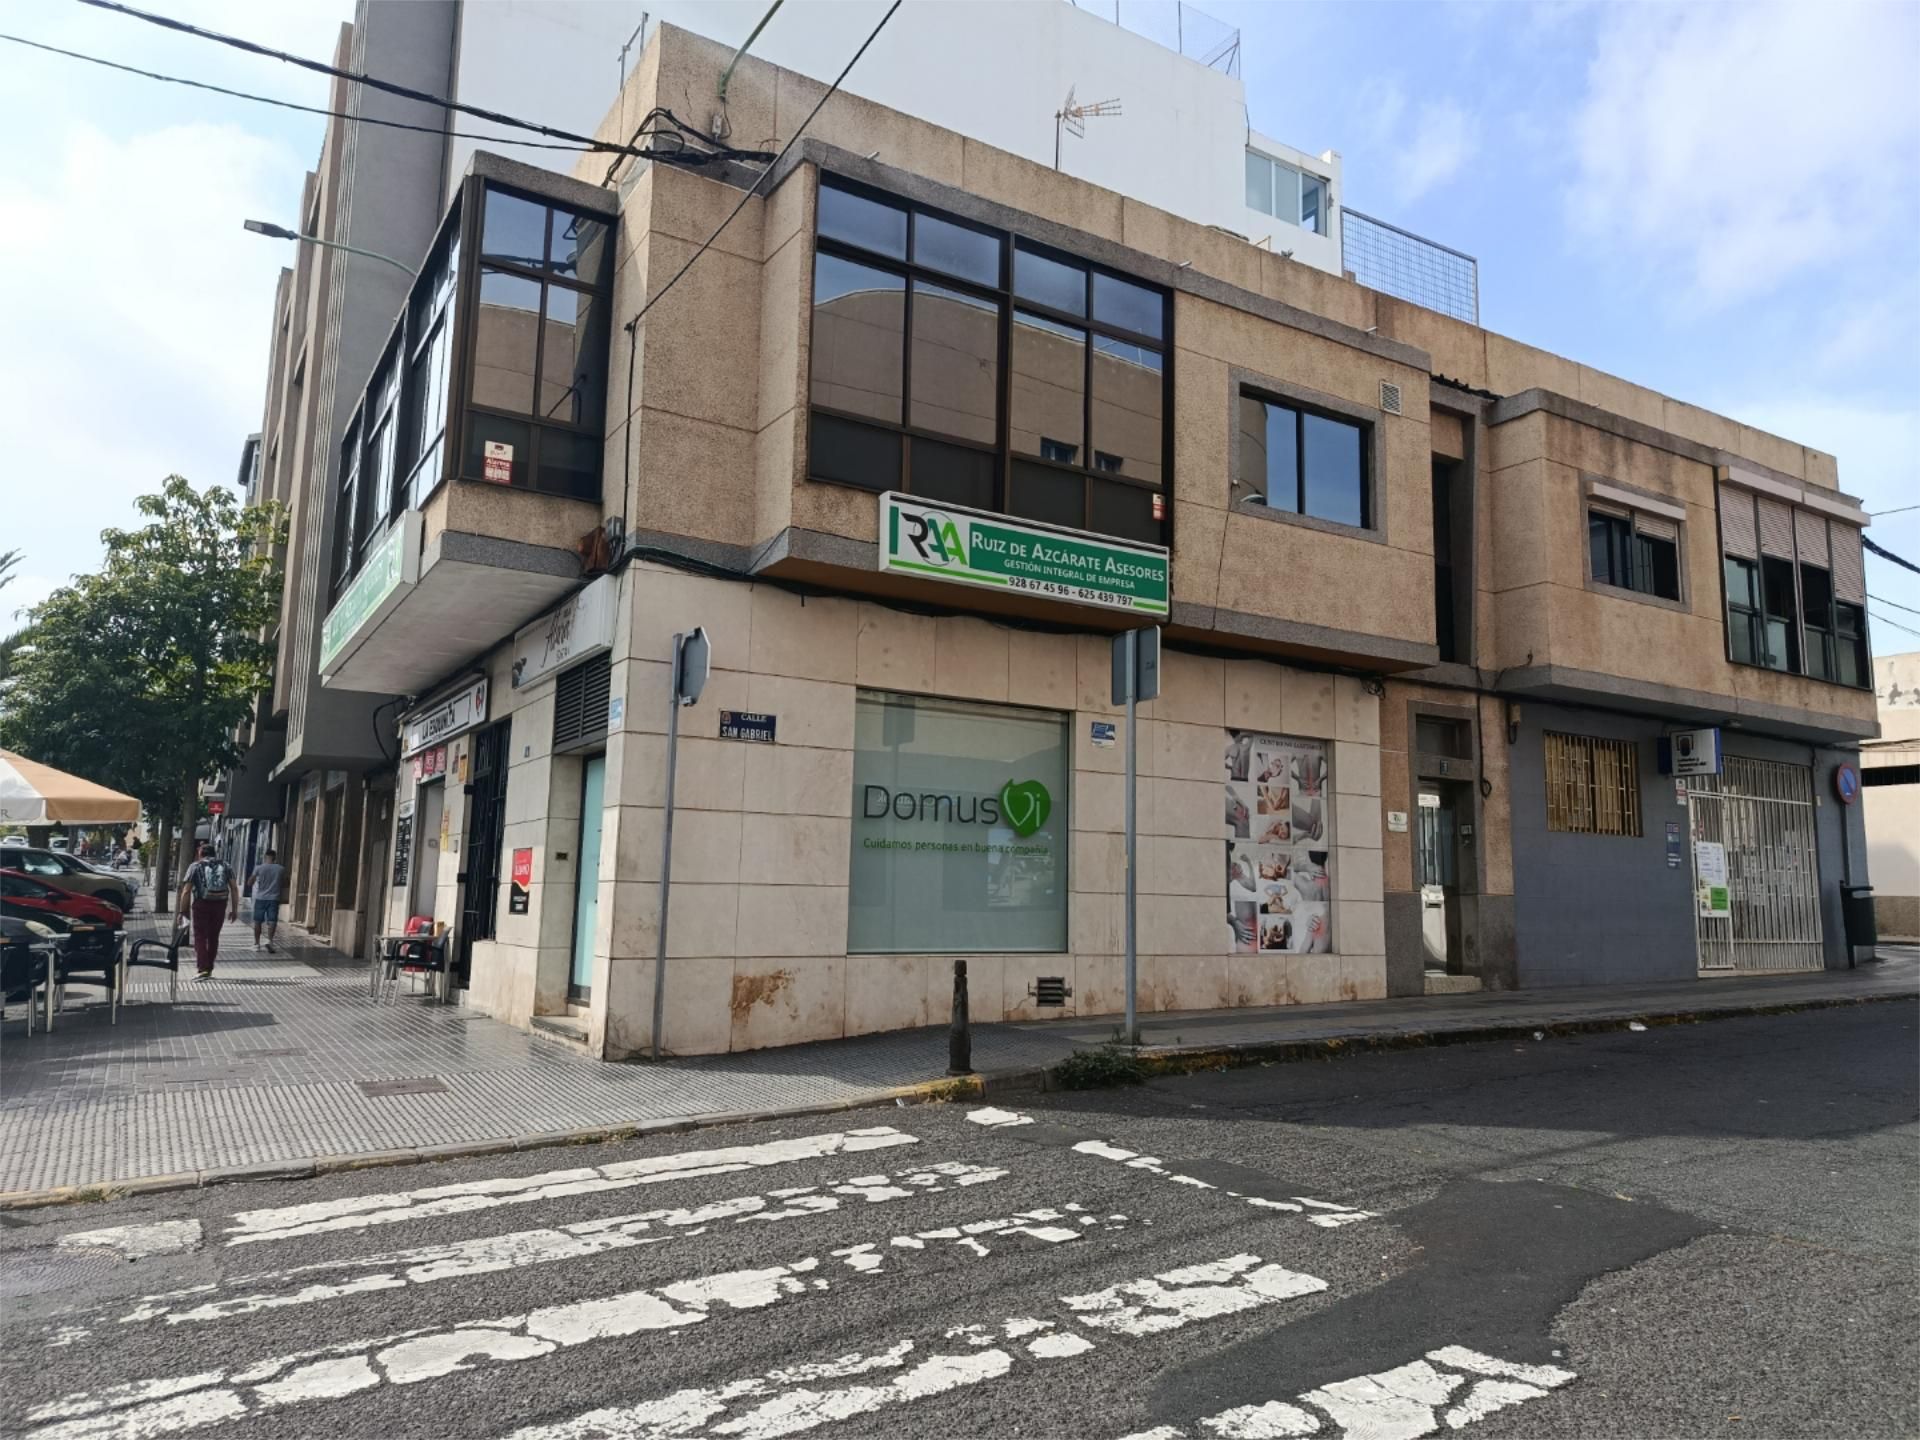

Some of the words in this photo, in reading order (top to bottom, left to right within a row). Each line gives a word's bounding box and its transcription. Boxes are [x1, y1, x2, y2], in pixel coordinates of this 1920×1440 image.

[971, 531, 1006, 553] RUIZ
[1010, 543, 1027, 557] DE
[1032, 543, 1101, 570] AZCÁRATE
[1105, 557, 1165, 581] ASESORES
[1004, 558, 1041, 573] GESTIÓN
[1043, 566, 1084, 581] INTEGRAL
[1086, 573, 1097, 583] DE
[1098, 575, 1136, 590] EMPRESA
[1008, 576, 1027, 588] 928
[1029, 579, 1041, 590] 67
[1043, 582, 1055, 593] 45
[1058, 585, 1069, 595] 96
[1078, 588, 1095, 600] 625
[1097, 592, 1114, 603] 439
[1117, 595, 1133, 606] 797
[740, 713, 768, 722] CALLE
[722, 726, 738, 738] SAN
[740, 727, 773, 741] GABRIEL
[863, 838, 912, 849] Cuidamos
[915, 841, 960, 852] personas
[961, 843, 973, 853] en
[975, 842, 1004, 853] buena
